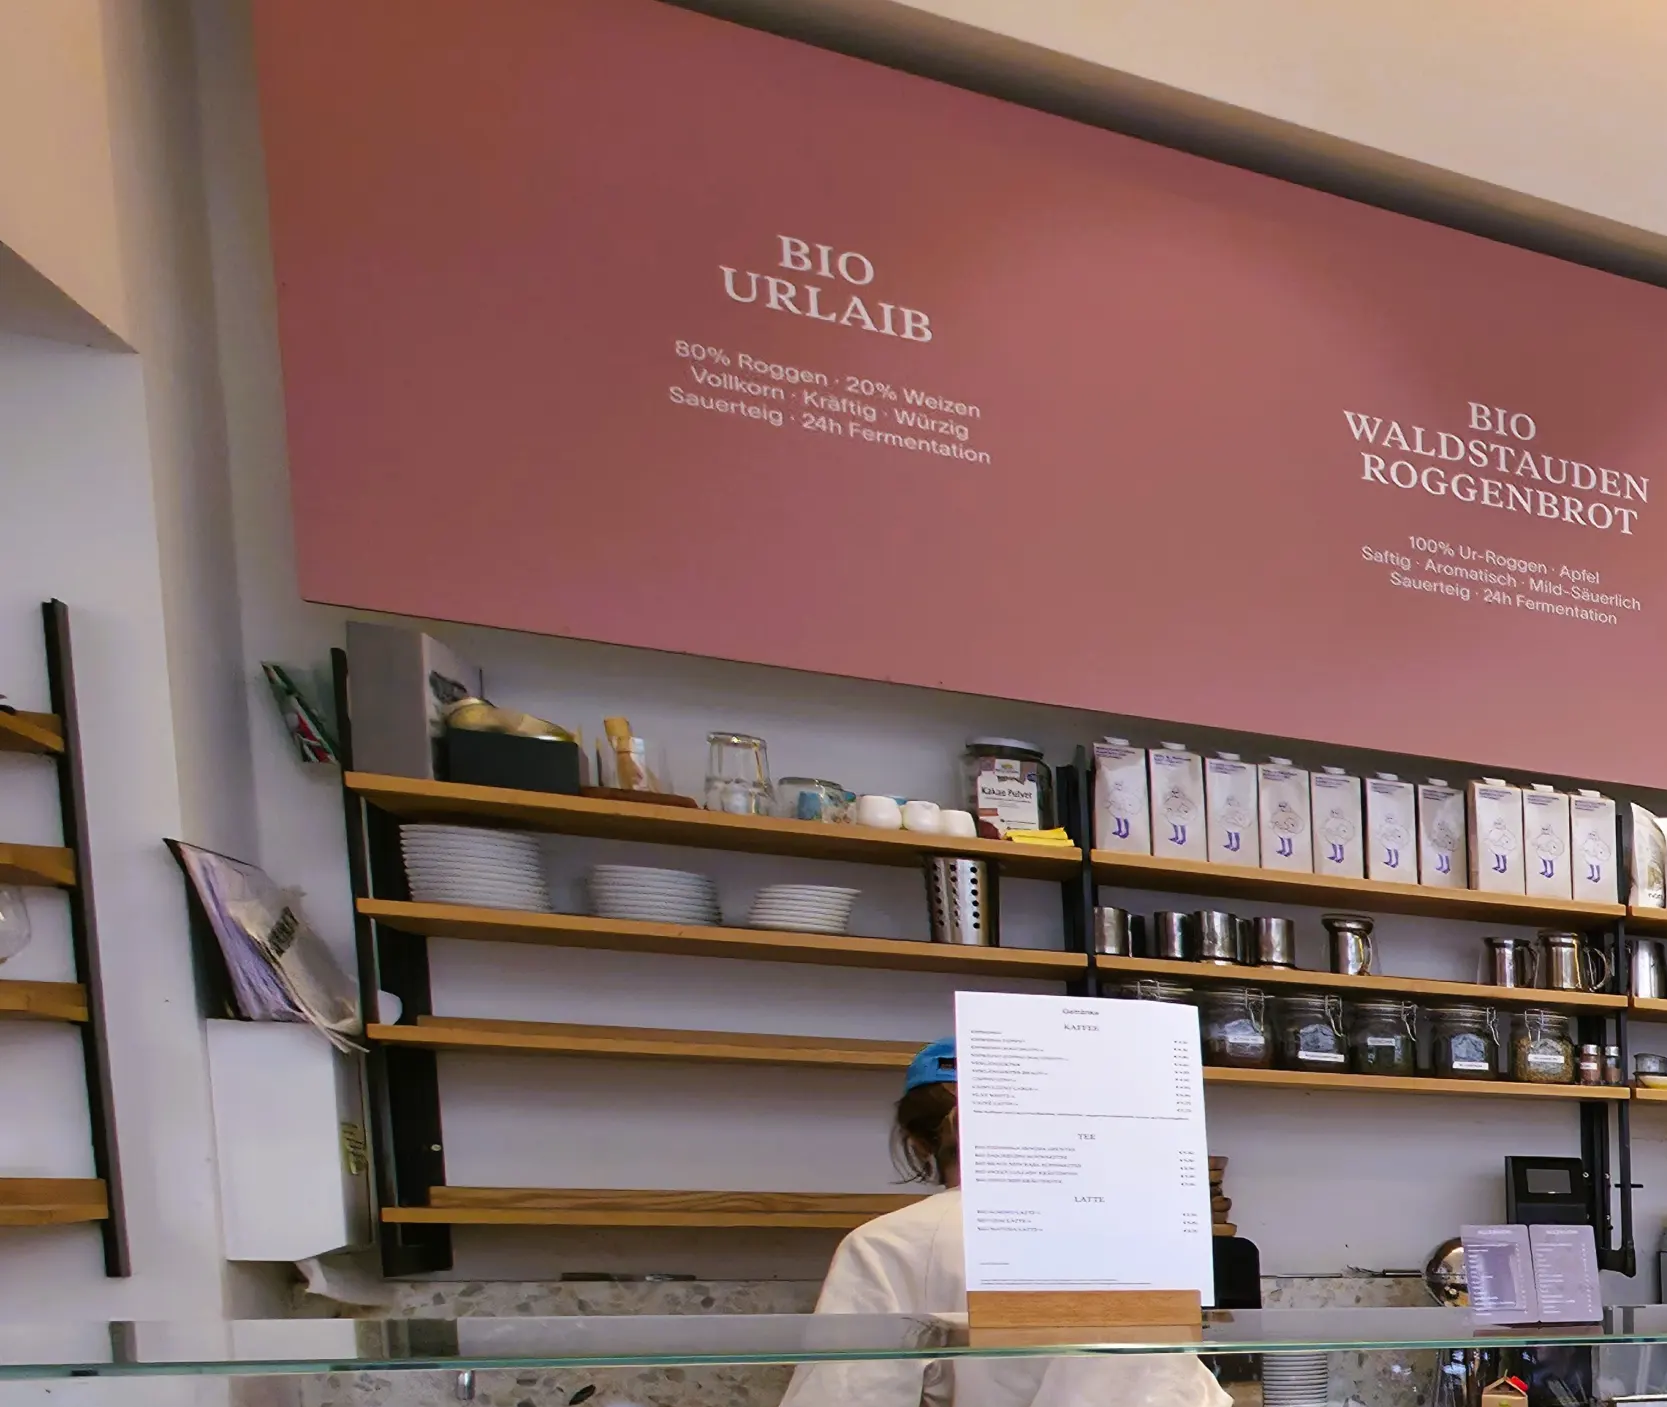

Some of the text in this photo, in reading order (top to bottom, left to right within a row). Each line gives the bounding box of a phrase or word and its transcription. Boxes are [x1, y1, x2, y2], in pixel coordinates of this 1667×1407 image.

[777, 234, 874, 285] BIO
[719, 265, 932, 342] URLAIB
[675, 340, 980, 419] 80% Roggen 20% Weizen
[690, 365, 969, 442] Vollkorn Kräftig Würzig
[669, 386, 991, 464] Sauerteig 24h Fermentation
[1468, 401, 1536, 440] BIO
[1343, 409, 1649, 503] WALDSTAUDEN
[1360, 452, 1638, 535] ROGGENBROT
[1361, 545, 1641, 612] Saftig Aromatisch Mild-Säuerlich
[1408, 536, 1600, 585] 100% Ur-Roggen Apfel
[1390, 571, 1617, 625] Sauerteig 24h Fermentation
[1077, 1133, 1096, 1141] TEE
[1074, 1196, 1105, 1204] LATTE
